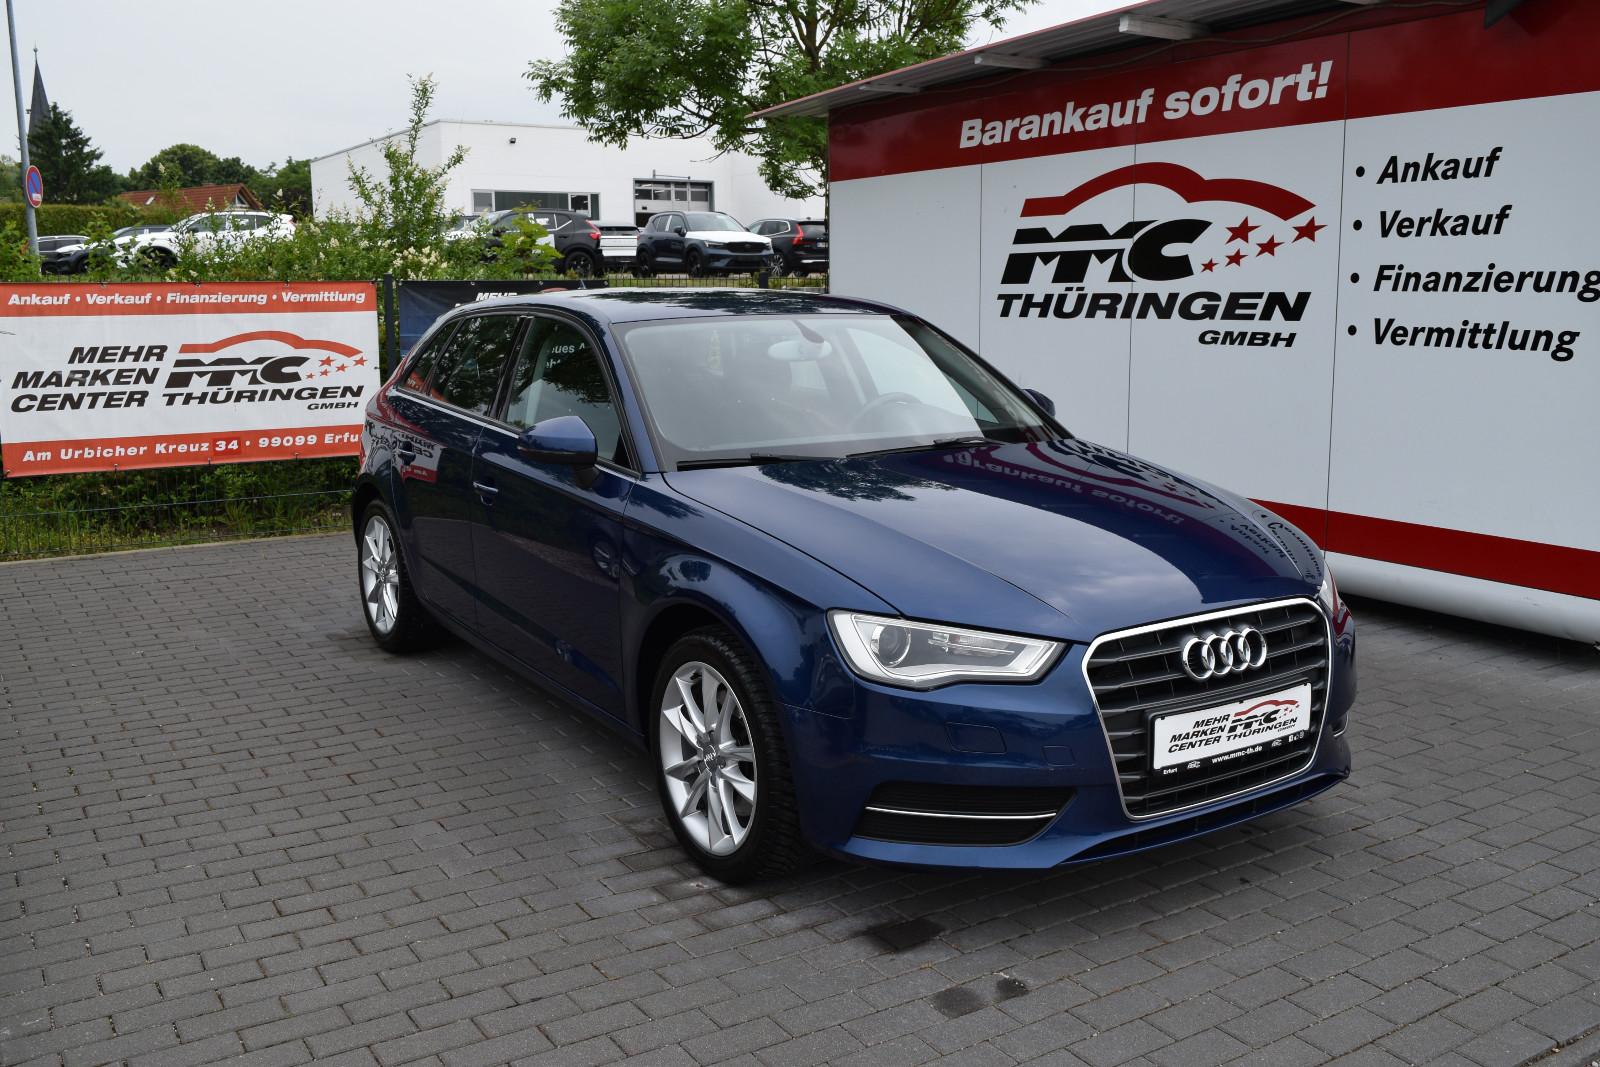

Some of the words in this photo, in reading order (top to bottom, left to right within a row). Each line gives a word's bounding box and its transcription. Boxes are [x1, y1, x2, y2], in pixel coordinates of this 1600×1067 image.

[959, 88, 1155, 149] Barankauf
[1163, 60, 1333, 119] sofort!
[1376, 146, 1503, 184] Ankauf
[1379, 205, 1512, 238] Verkauf
[1000, 218, 1213, 284] MMC
[1373, 262, 1600, 302] Finanzierung
[8, 294, 71, 305] Ankauf
[86, 293, 152, 305] Verkauf
[166, 292, 268, 305] Finanzierung
[281, 291, 366, 304] Vermittlung
[997, 286, 1311, 321] THÜRINGEN
[1198, 329, 1297, 348] GMBH
[1373, 318, 1580, 361] Vermittlung
[68, 345, 168, 364] MEHR
[11, 367, 160, 389] MARKEN
[165, 356, 311, 389] MMC
[11, 390, 150, 413] CENTER
[162, 385, 365, 407] THÜRINGEN
[307, 401, 359, 411] GMBH
[23, 450, 52, 462] Am
[60, 445, 148, 460] Urbicher
[155, 442, 209, 454] Kreuz
[215, 440, 239, 451] 34
[258, 435, 317, 448] 99099
[1193, 714, 1231, 729] MEHR
[1226, 717, 1298, 742] THÜRINGEN
[1168, 736, 1222, 754] CENTER
[1169, 725, 1227, 744] MARKEN
